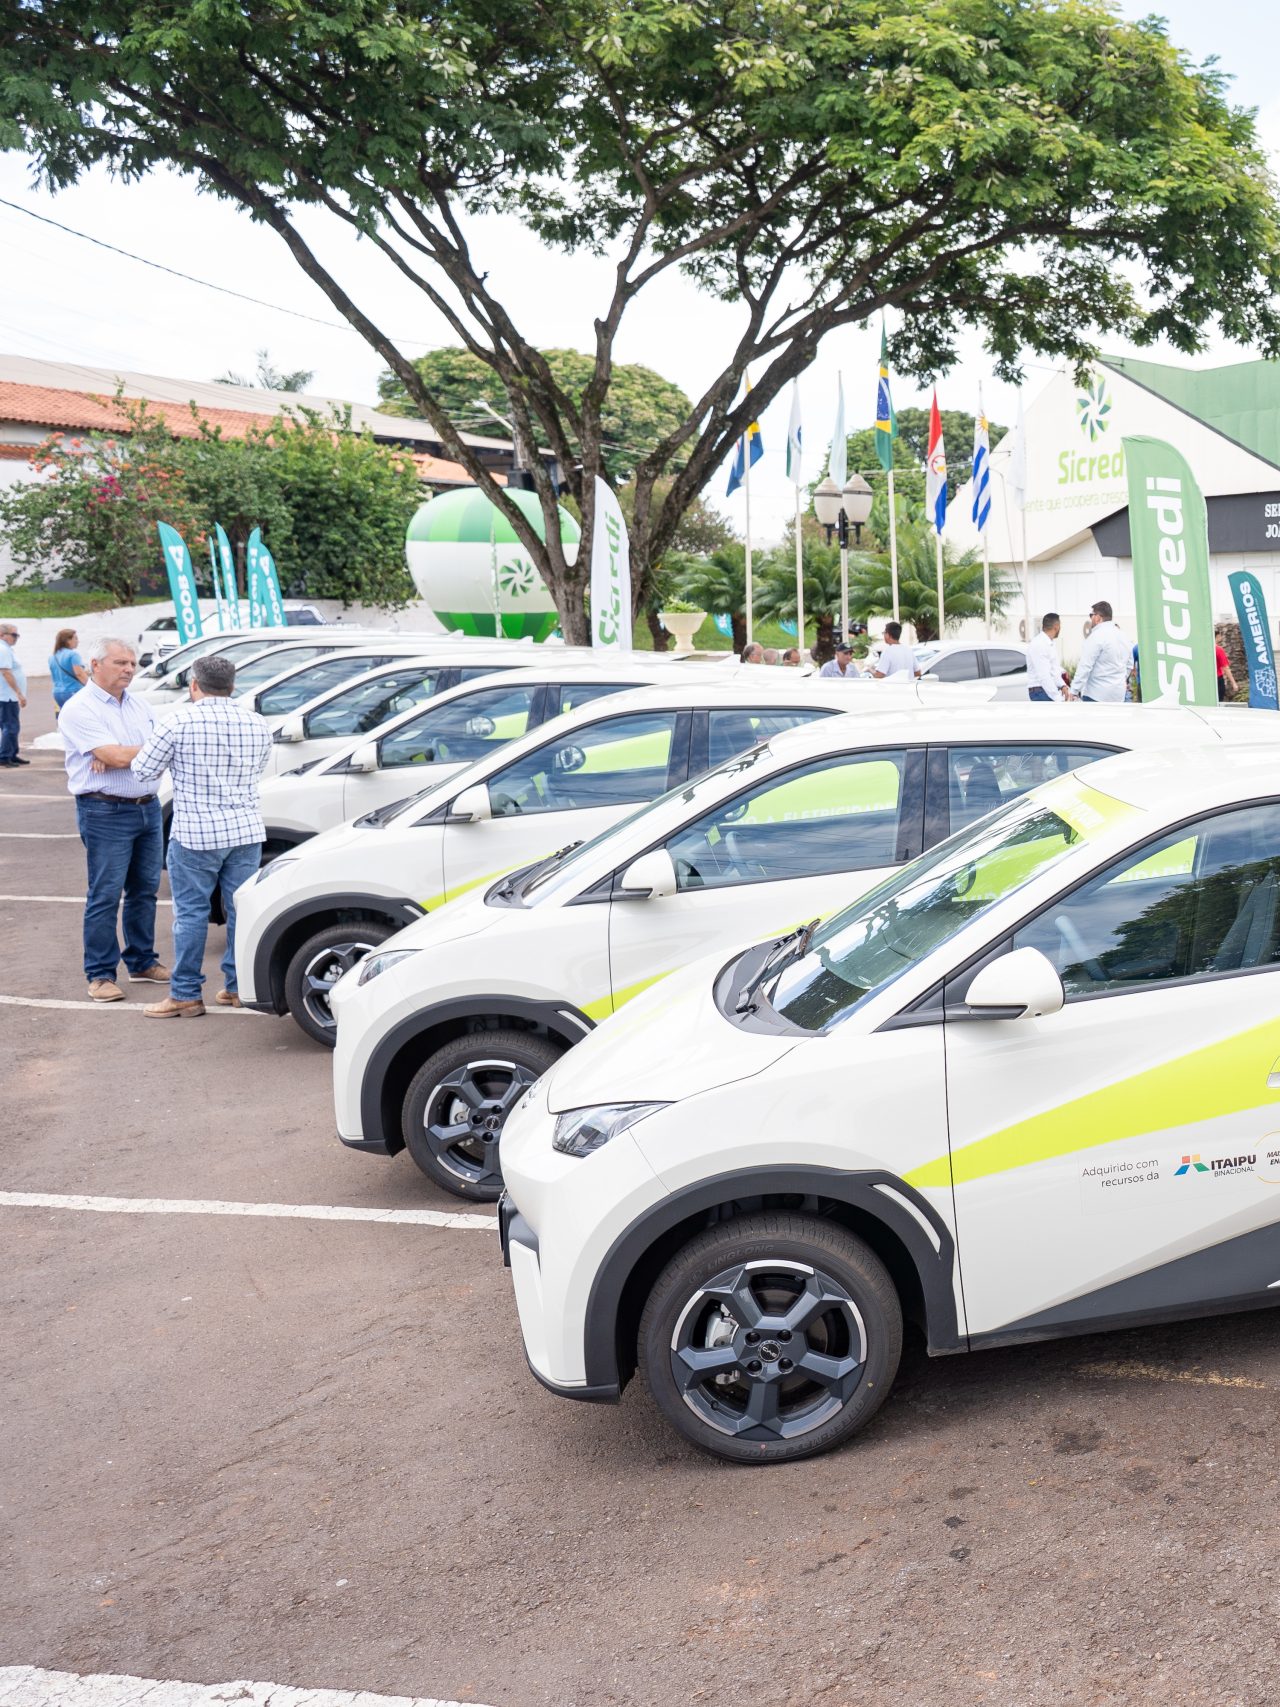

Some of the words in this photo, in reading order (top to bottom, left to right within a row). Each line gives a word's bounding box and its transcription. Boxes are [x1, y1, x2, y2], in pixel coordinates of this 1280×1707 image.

[1058, 447, 1125, 484] Sicred
[1146, 477, 1195, 704] Sicredi
[1240, 581, 1269, 665] AMERIOS
[1082, 1163, 1133, 1177] Adquirido
[1136, 1158, 1159, 1169] com
[1210, 1154, 1257, 1171] ITAIPU
[1214, 1165, 1255, 1178] BINACIONAL
[1101, 1174, 1144, 1188] recursos
[1146, 1170, 1160, 1182] da
